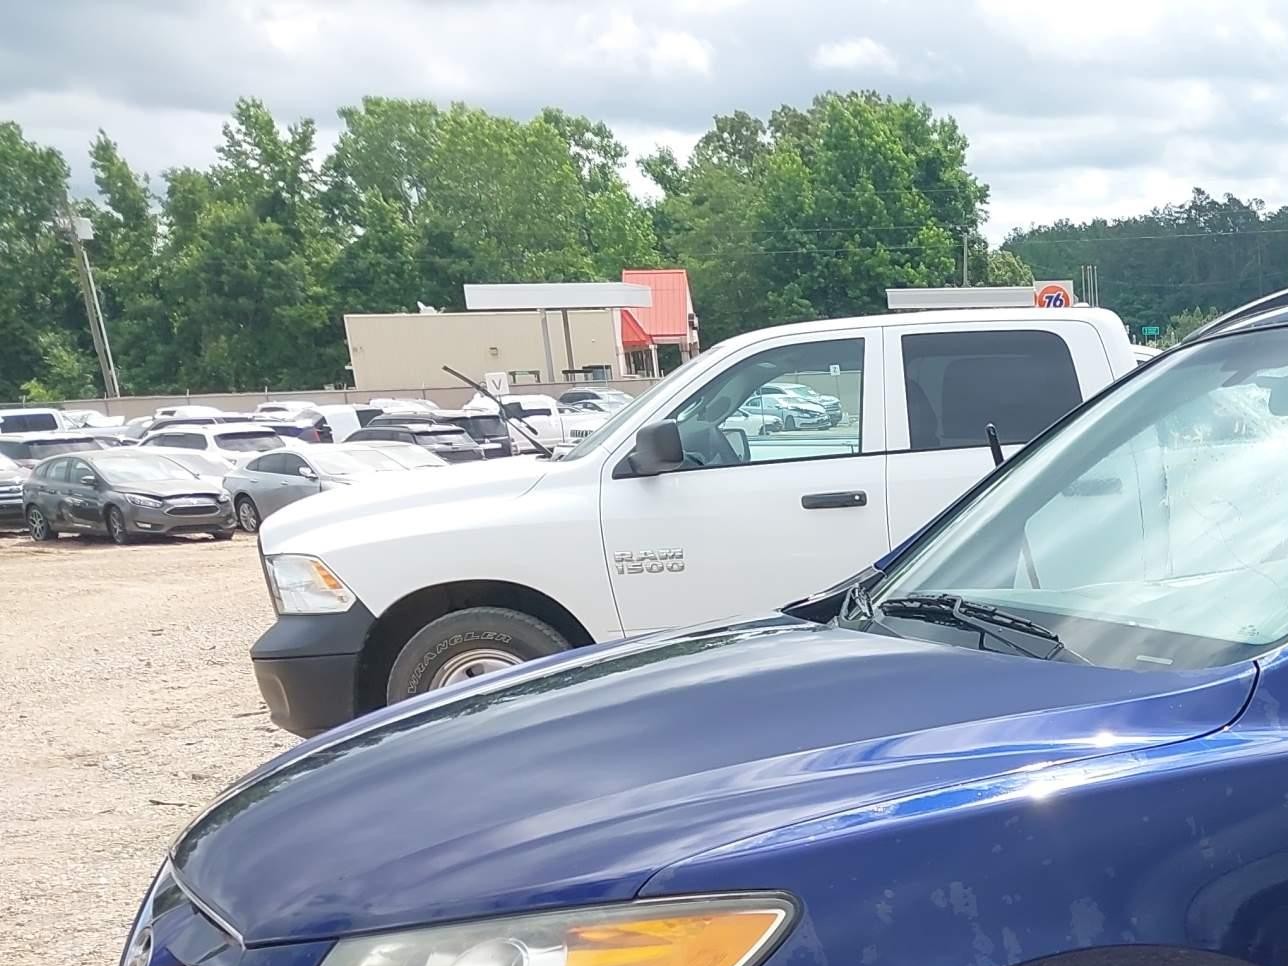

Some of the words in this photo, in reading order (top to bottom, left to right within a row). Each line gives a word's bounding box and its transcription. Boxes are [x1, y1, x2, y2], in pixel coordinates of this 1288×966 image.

[1044, 292, 1064, 308] 76
[491, 378, 502, 390] V
[614, 547, 684, 562] RAM
[615, 561, 685, 575] 1500
[407, 631, 513, 694] WRANGLER
